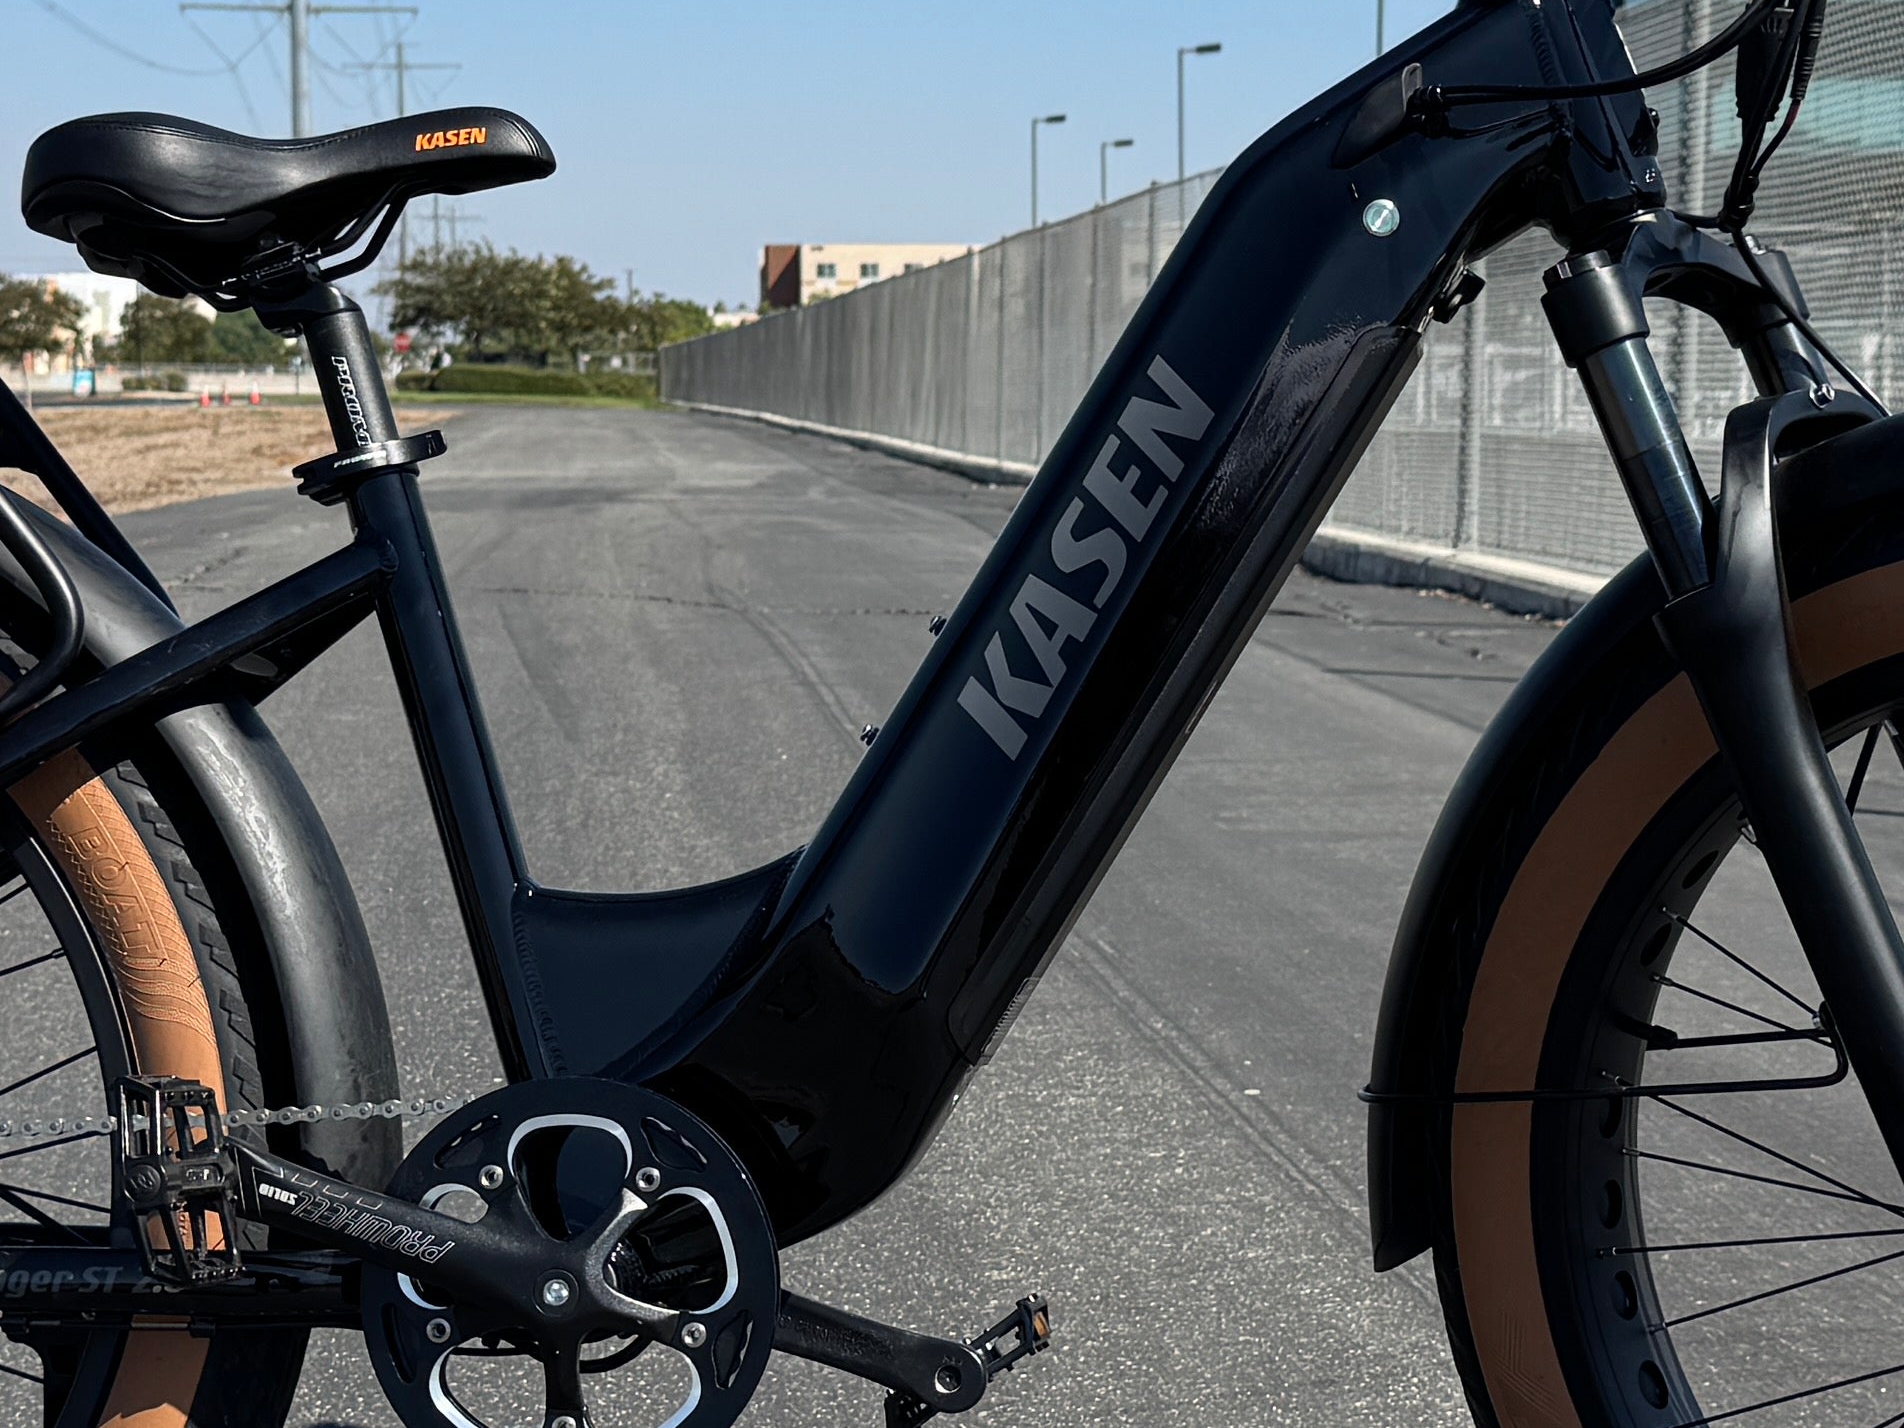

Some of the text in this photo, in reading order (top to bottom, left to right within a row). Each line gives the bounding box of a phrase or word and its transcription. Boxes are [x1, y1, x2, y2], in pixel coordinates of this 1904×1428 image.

[415, 127, 486, 151] KASEN
[956, 354, 1215, 761] KASEN
[291, 1190, 456, 1264] PROWHEEL
[78, 1266, 124, 1293] ST
